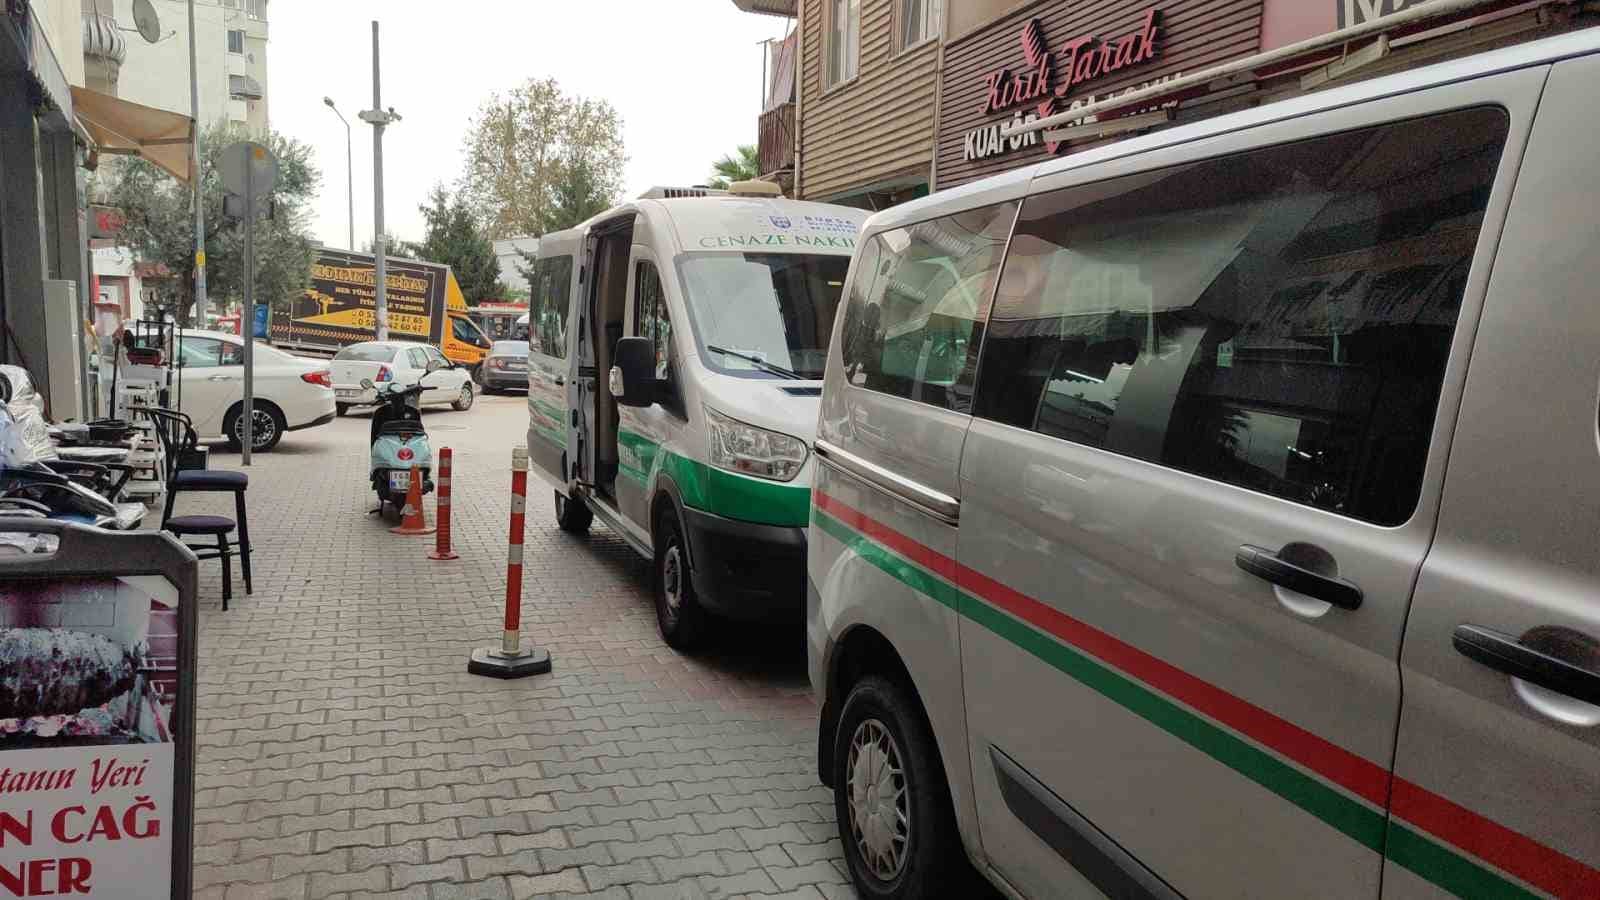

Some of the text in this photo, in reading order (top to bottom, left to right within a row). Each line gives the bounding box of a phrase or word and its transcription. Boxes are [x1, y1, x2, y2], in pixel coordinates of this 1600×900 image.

[1055, 9, 1160, 97] Tarak
[963, 111, 1038, 161] KUAFÖR
[699, 234, 787, 248] CENAZE
[90, 757, 150, 795] Yeri
[51, 795, 161, 844] CAĞ
